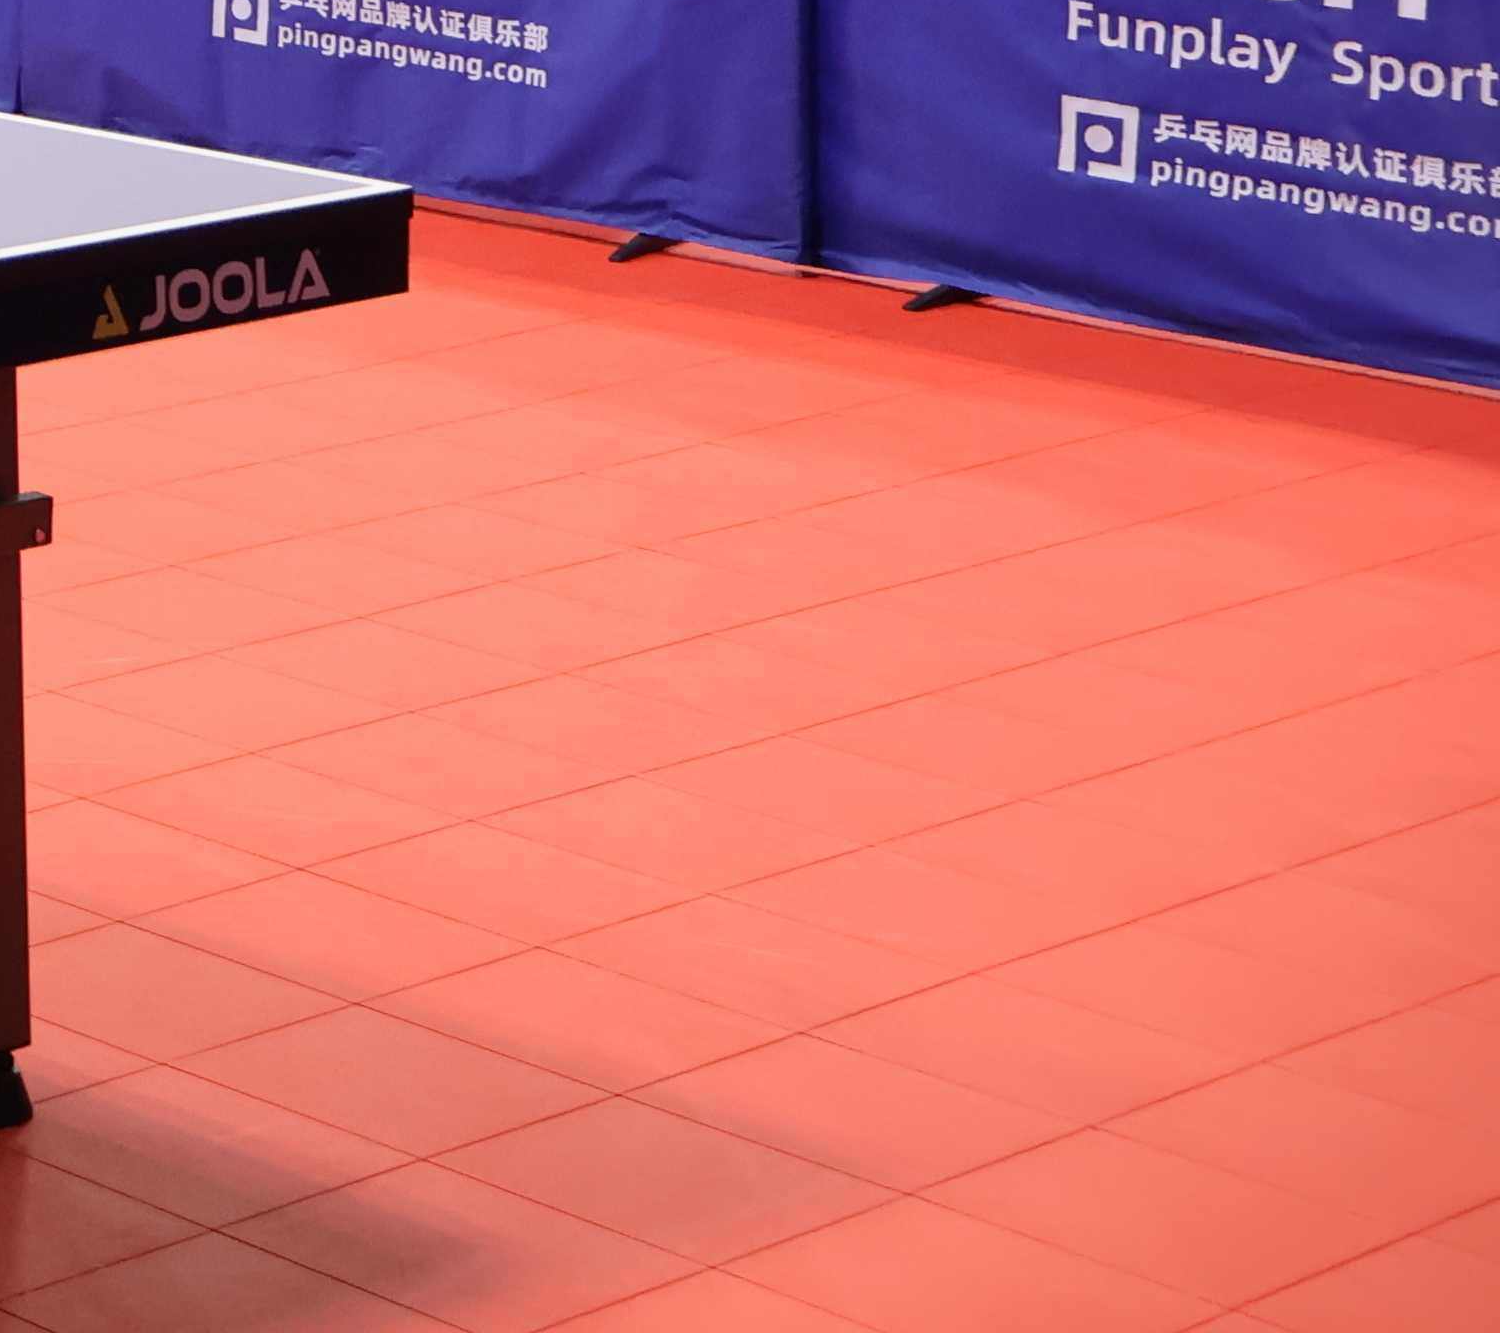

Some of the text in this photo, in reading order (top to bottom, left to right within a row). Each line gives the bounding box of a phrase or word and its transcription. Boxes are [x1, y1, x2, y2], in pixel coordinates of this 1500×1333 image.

[277, 22, 547, 88] pingpangwang.com
[1330, 40, 1500, 107] Sport
[1150, 156, 1500, 239] pingpangwang.co
[1153, 113, 1500, 199] 乒乓网品牌认证俱乐
[140, 247, 331, 331] JOOLA
